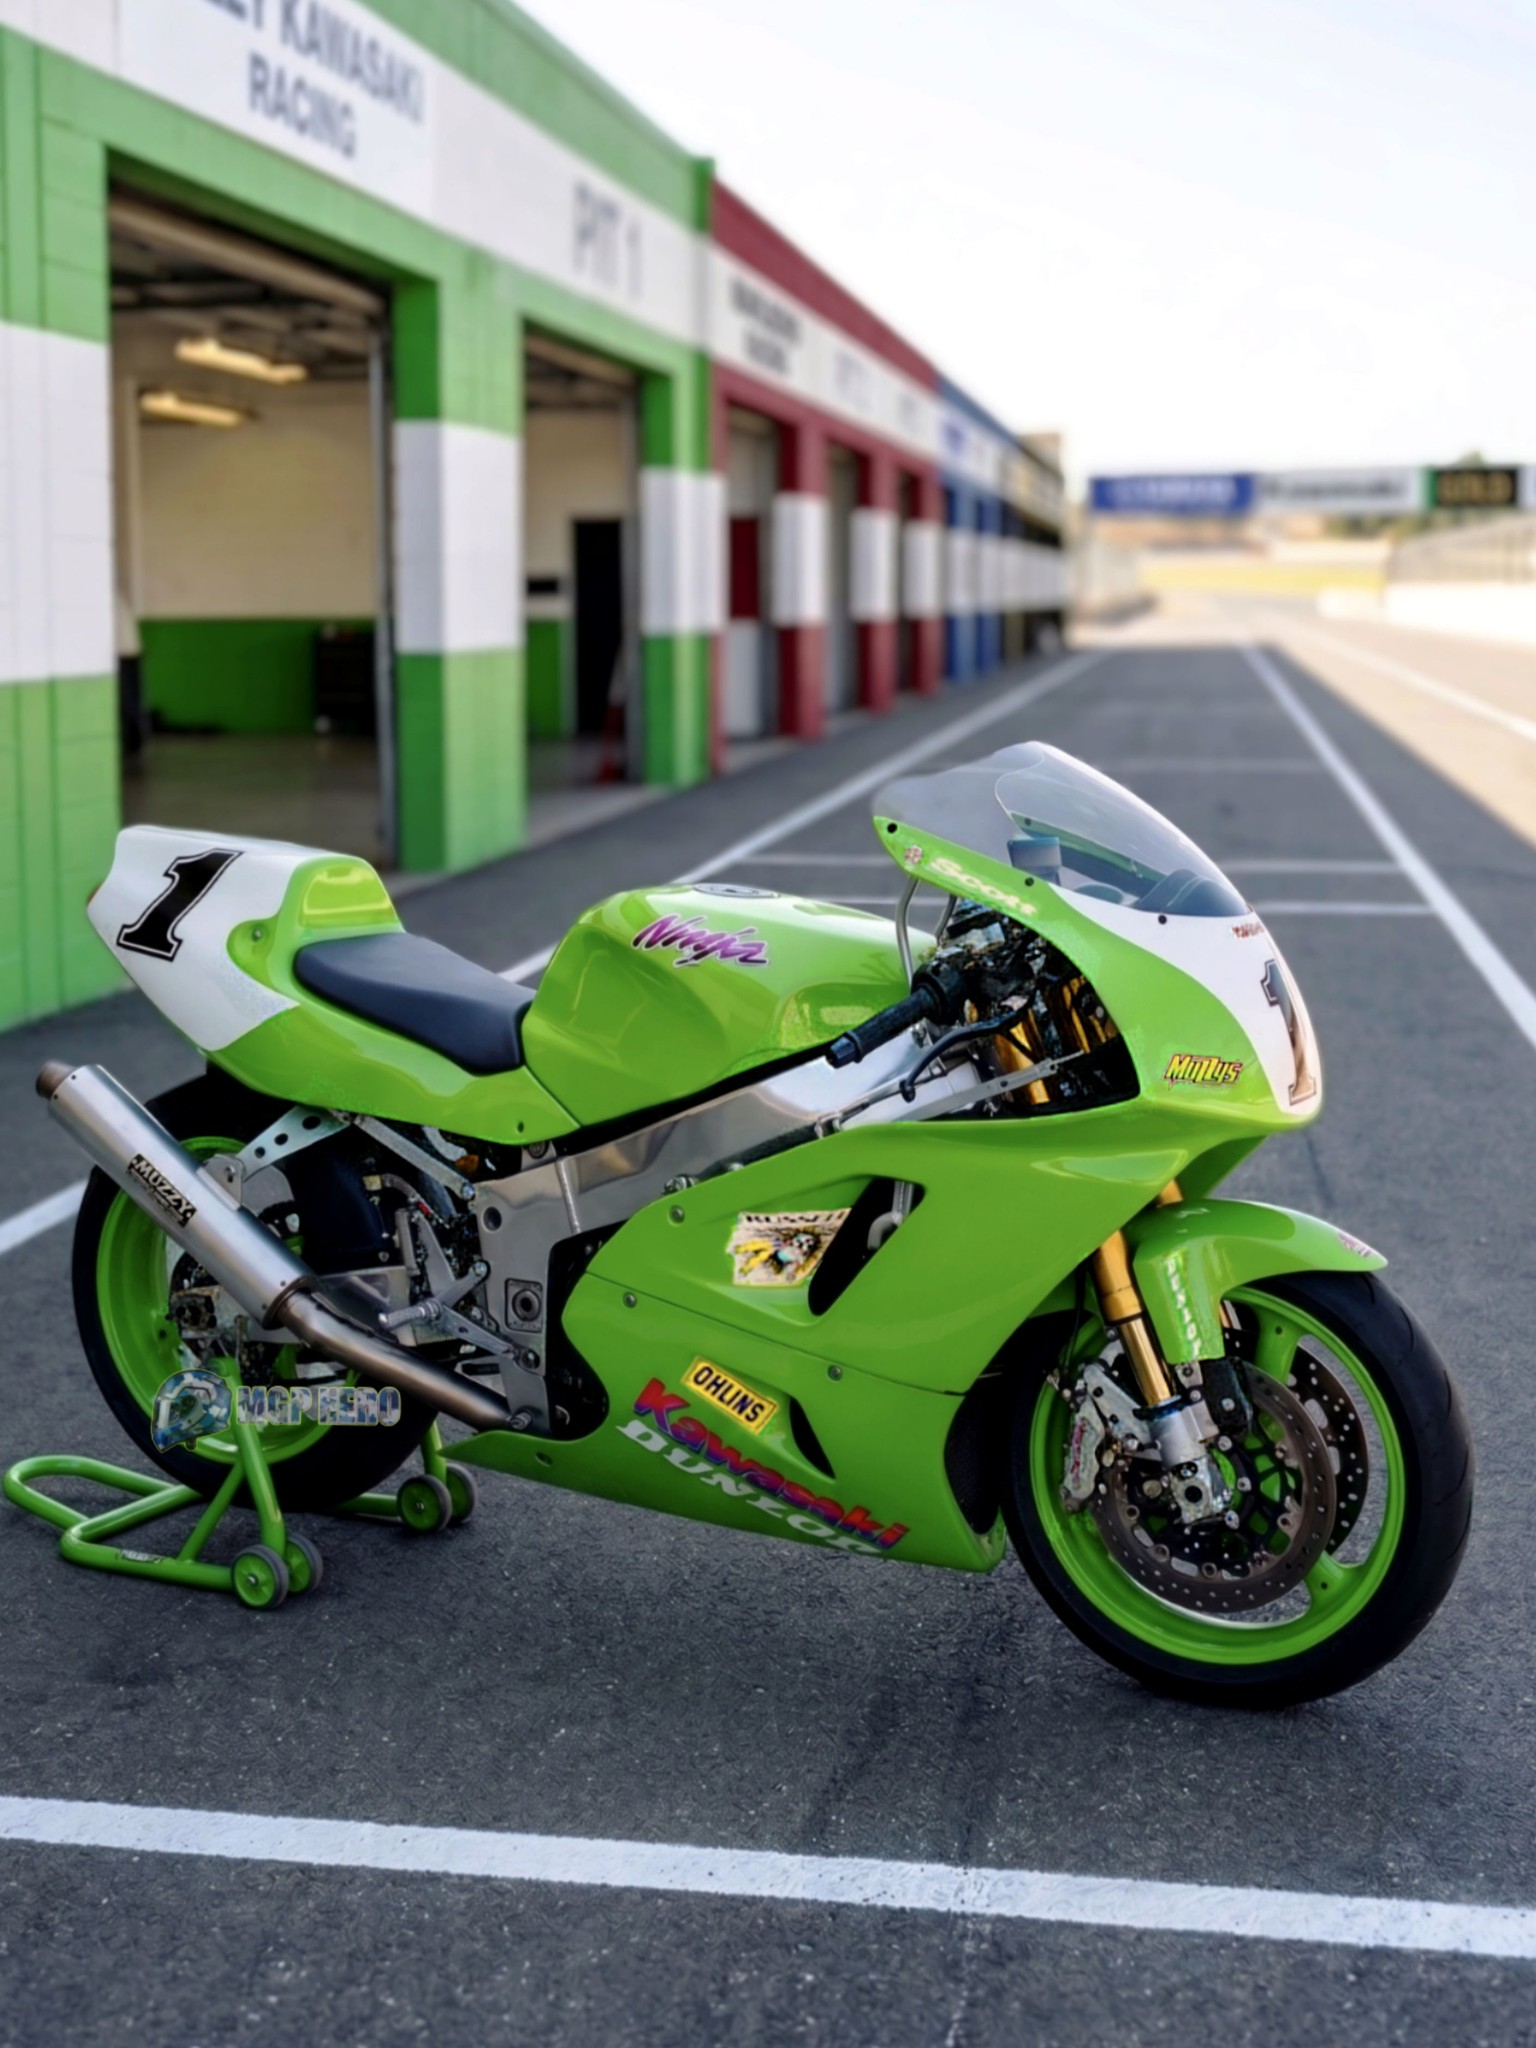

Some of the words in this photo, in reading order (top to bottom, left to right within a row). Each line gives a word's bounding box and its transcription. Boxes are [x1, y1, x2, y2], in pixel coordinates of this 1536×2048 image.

[249, 50, 356, 160] RACING
[116, 847, 244, 962] 1
[632, 913, 770, 968] Ninja
[134, 1160, 194, 1213] MUZZY
[693, 1366, 765, 1422] OHLINS
[632, 1377, 910, 1549] Kawasaki
